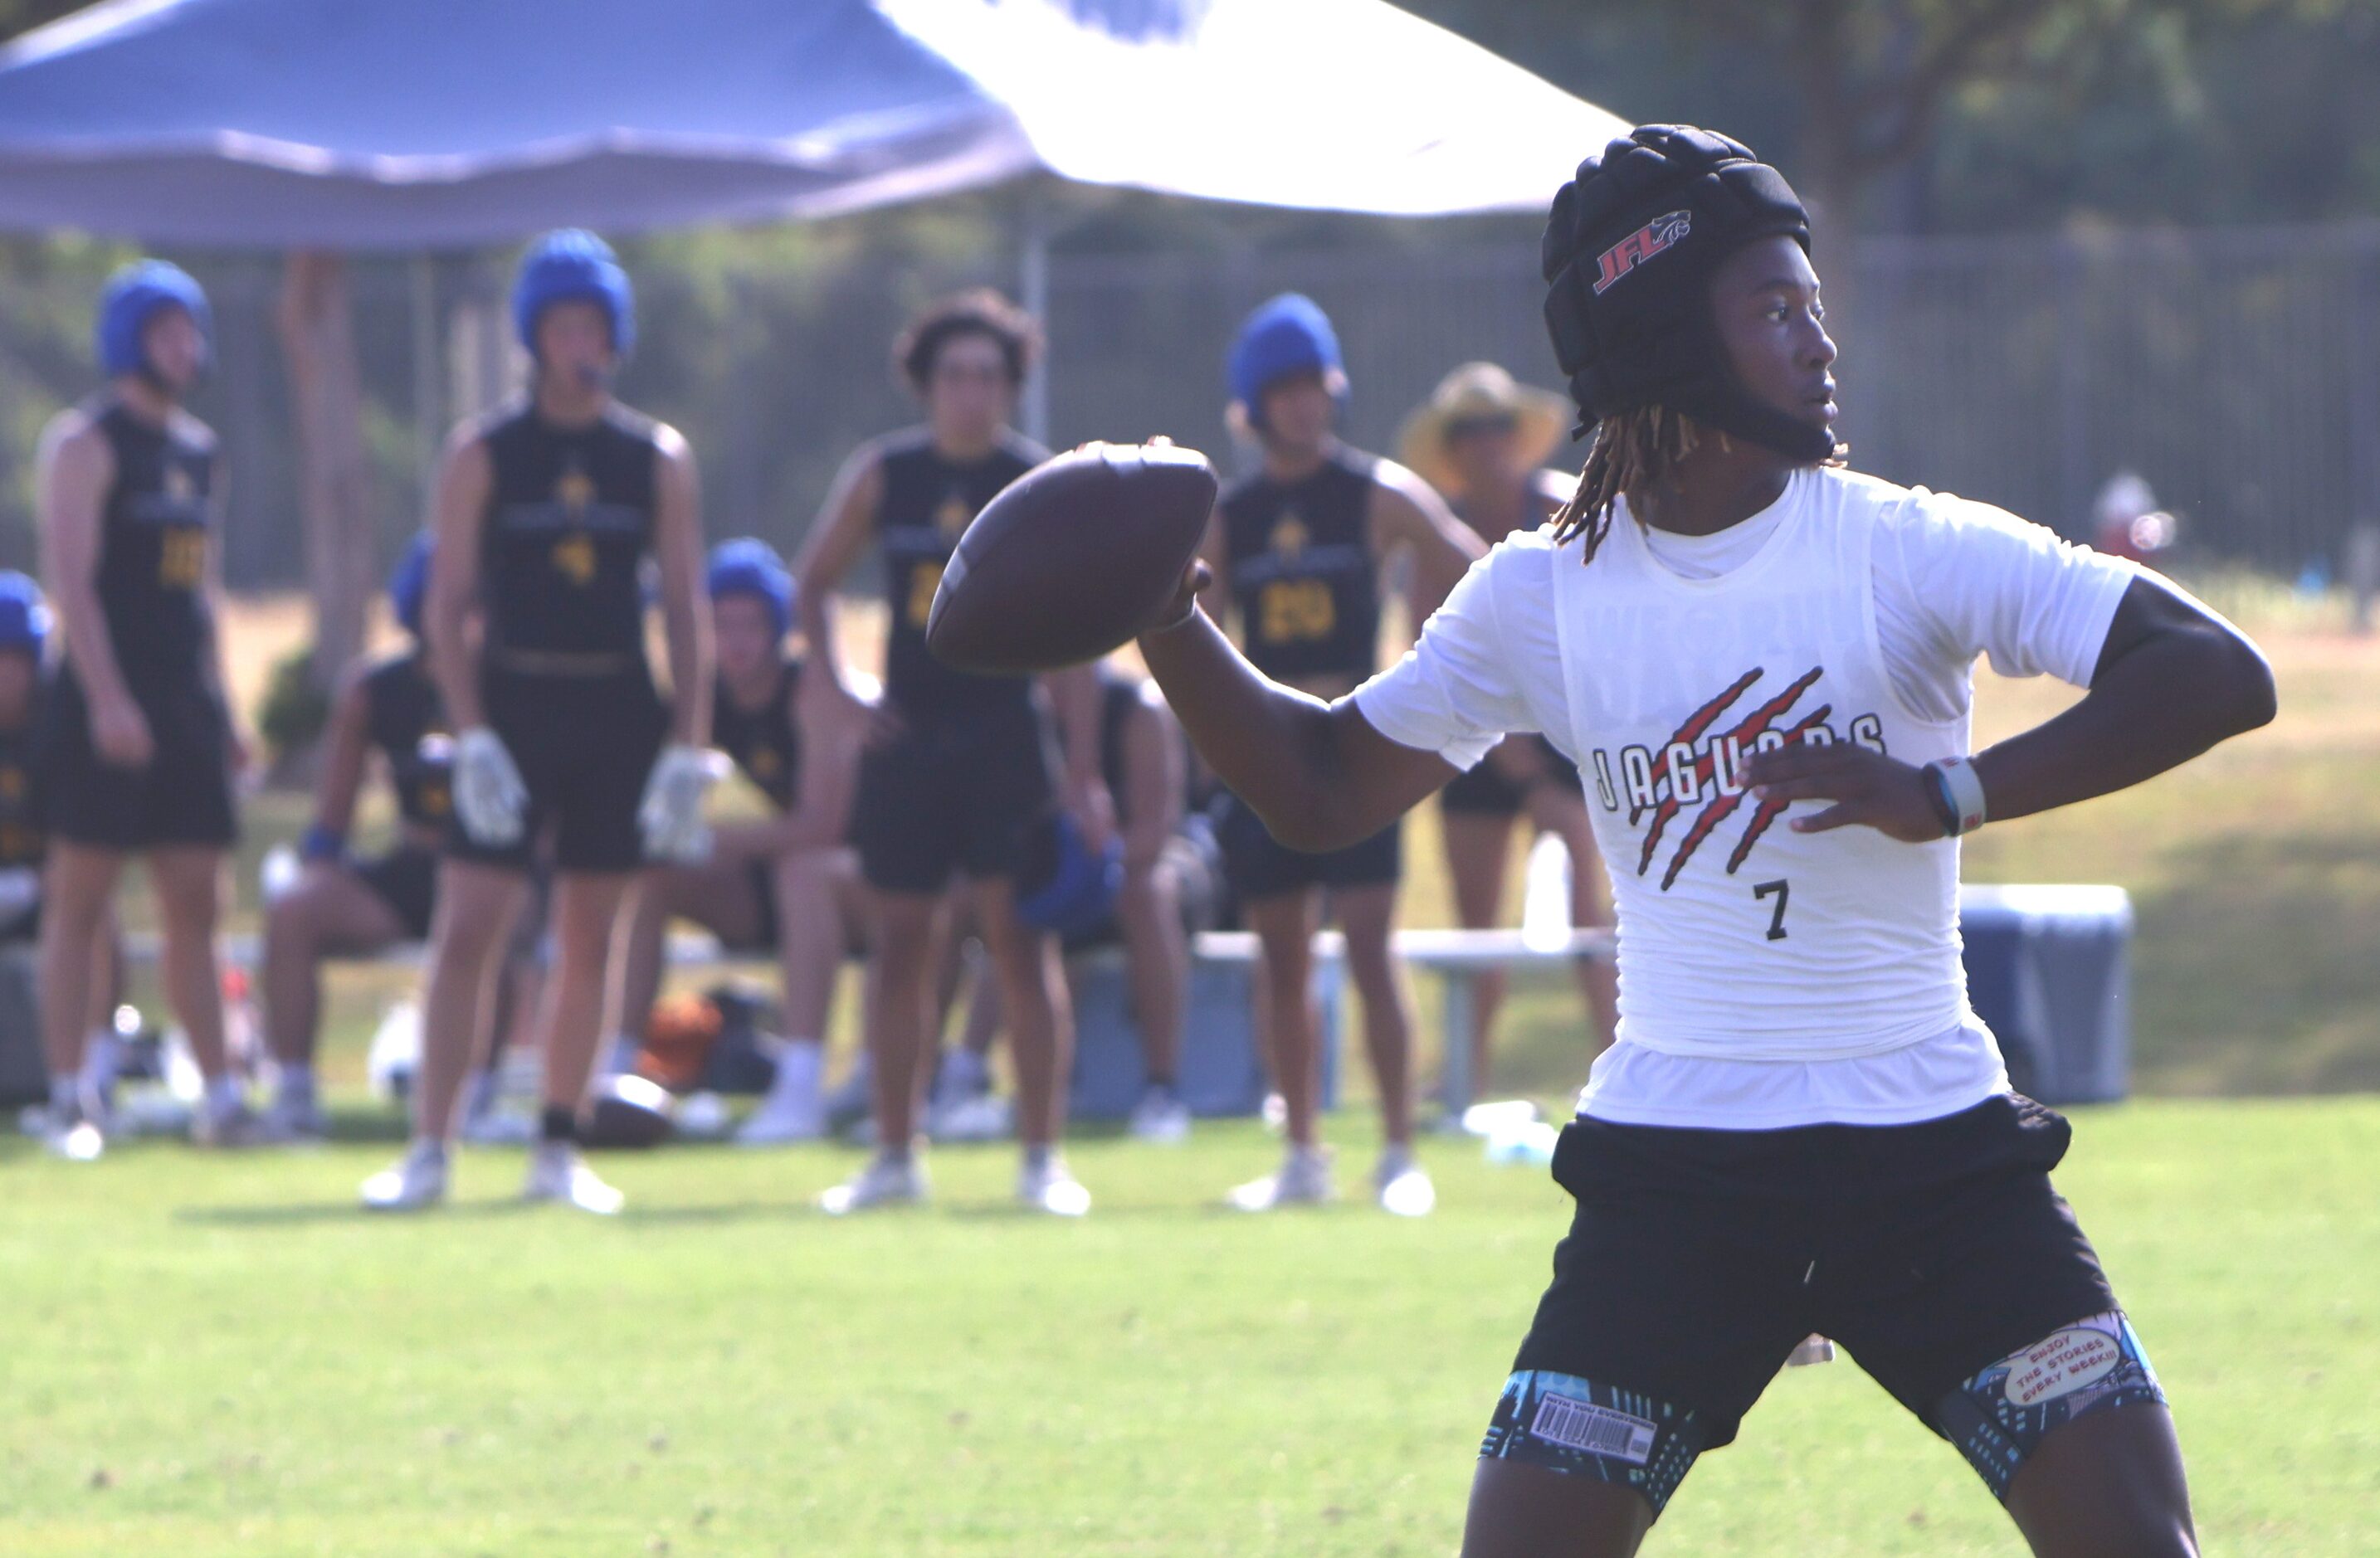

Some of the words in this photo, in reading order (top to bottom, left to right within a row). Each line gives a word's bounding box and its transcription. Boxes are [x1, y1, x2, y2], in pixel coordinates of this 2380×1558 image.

[1593, 223, 1668, 295] JFL
[1753, 878, 1791, 941] 7
[2017, 1366, 2042, 1387] THE
[2047, 1338, 2104, 1369] STORIES
[2030, 1335, 2070, 1363] ENJOY
[2022, 1371, 2062, 1402] EVERY
